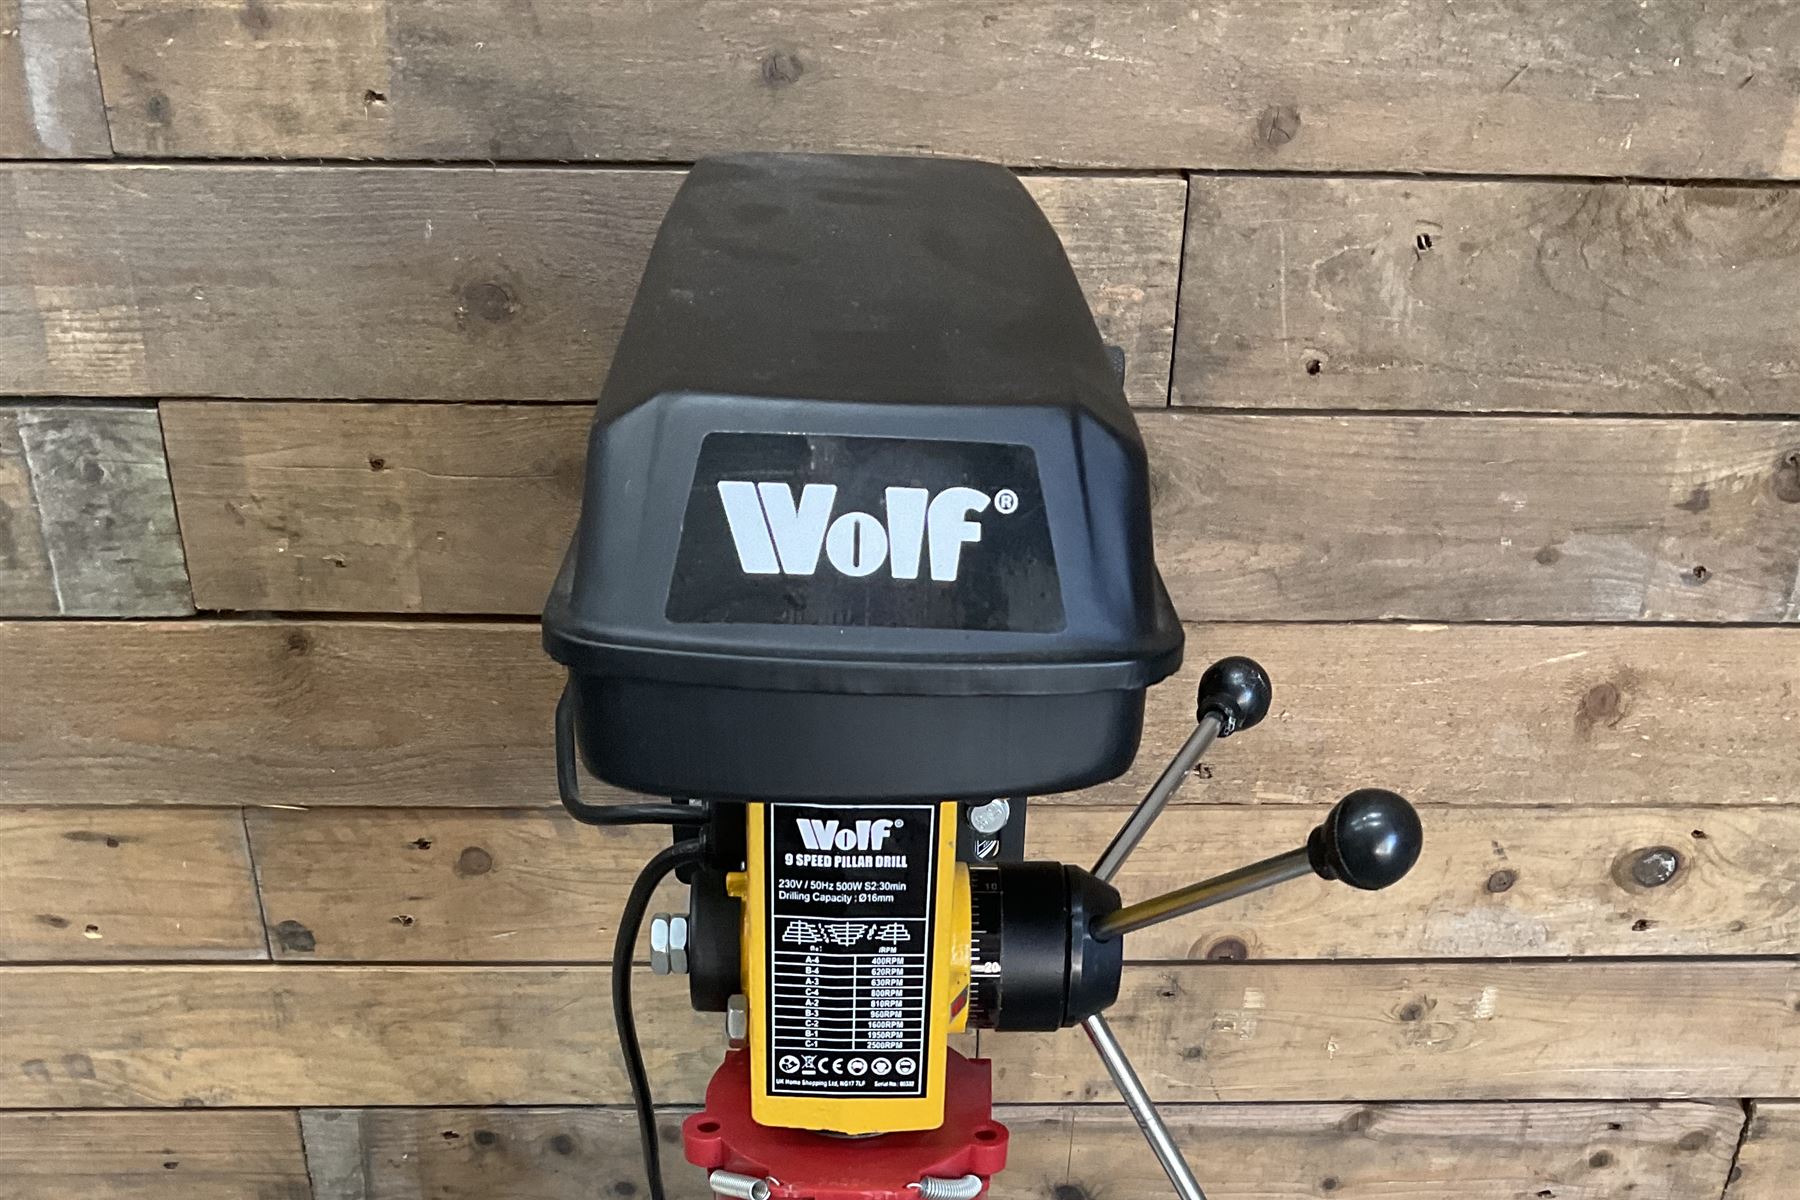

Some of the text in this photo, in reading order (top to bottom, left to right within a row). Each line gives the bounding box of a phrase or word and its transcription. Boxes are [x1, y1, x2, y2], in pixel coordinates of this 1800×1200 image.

[785, 853, 908, 868] 9 SPEED PILLAR DRILL
[778, 879, 803, 889] 230V
[810, 881, 834, 891] 50Hz
[835, 882, 863, 891] 500W
[778, 890, 810, 901] Drilling
[812, 893, 851, 905] Capacity
[805, 956, 819, 964] A-4
[984, 962, 1001, 973] 20
[805, 988, 819, 996] C-4
[805, 999, 819, 1007] A-2
[805, 1009, 819, 1017] B-3
[805, 1040, 819, 1048] C-1
[801, 1079, 827, 1087] Shopping
